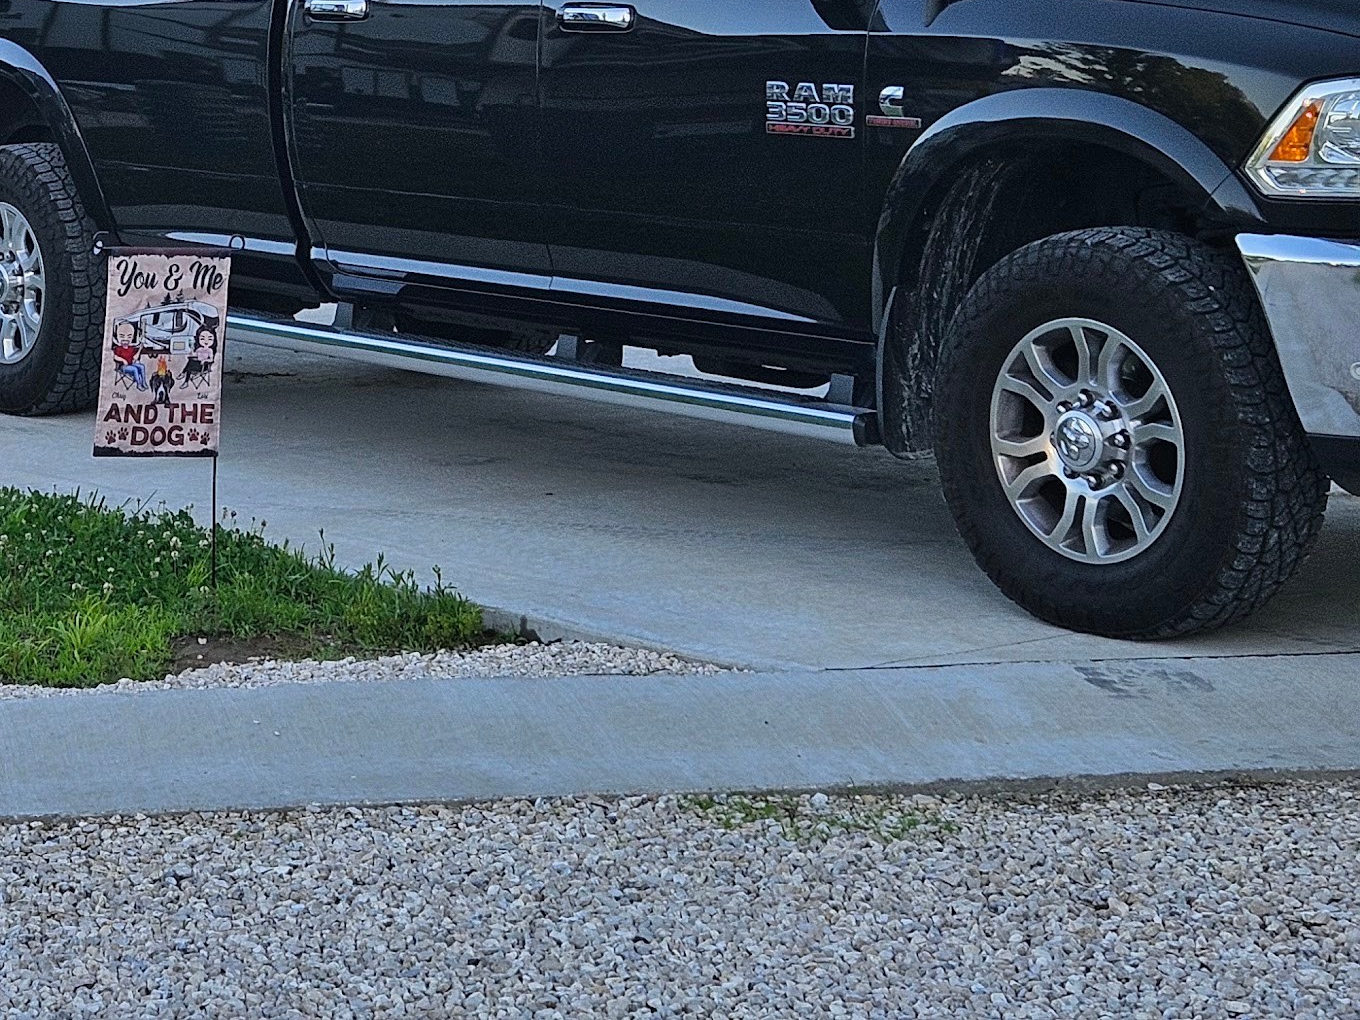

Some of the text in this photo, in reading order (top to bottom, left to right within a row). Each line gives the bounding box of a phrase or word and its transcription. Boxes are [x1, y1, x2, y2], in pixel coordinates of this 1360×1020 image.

[765, 80, 855, 105] RAM
[765, 100, 855, 126] 3500
[116, 259, 224, 297] You & Me
[103, 402, 215, 425] AND THE
[130, 425, 185, 447] DOG
